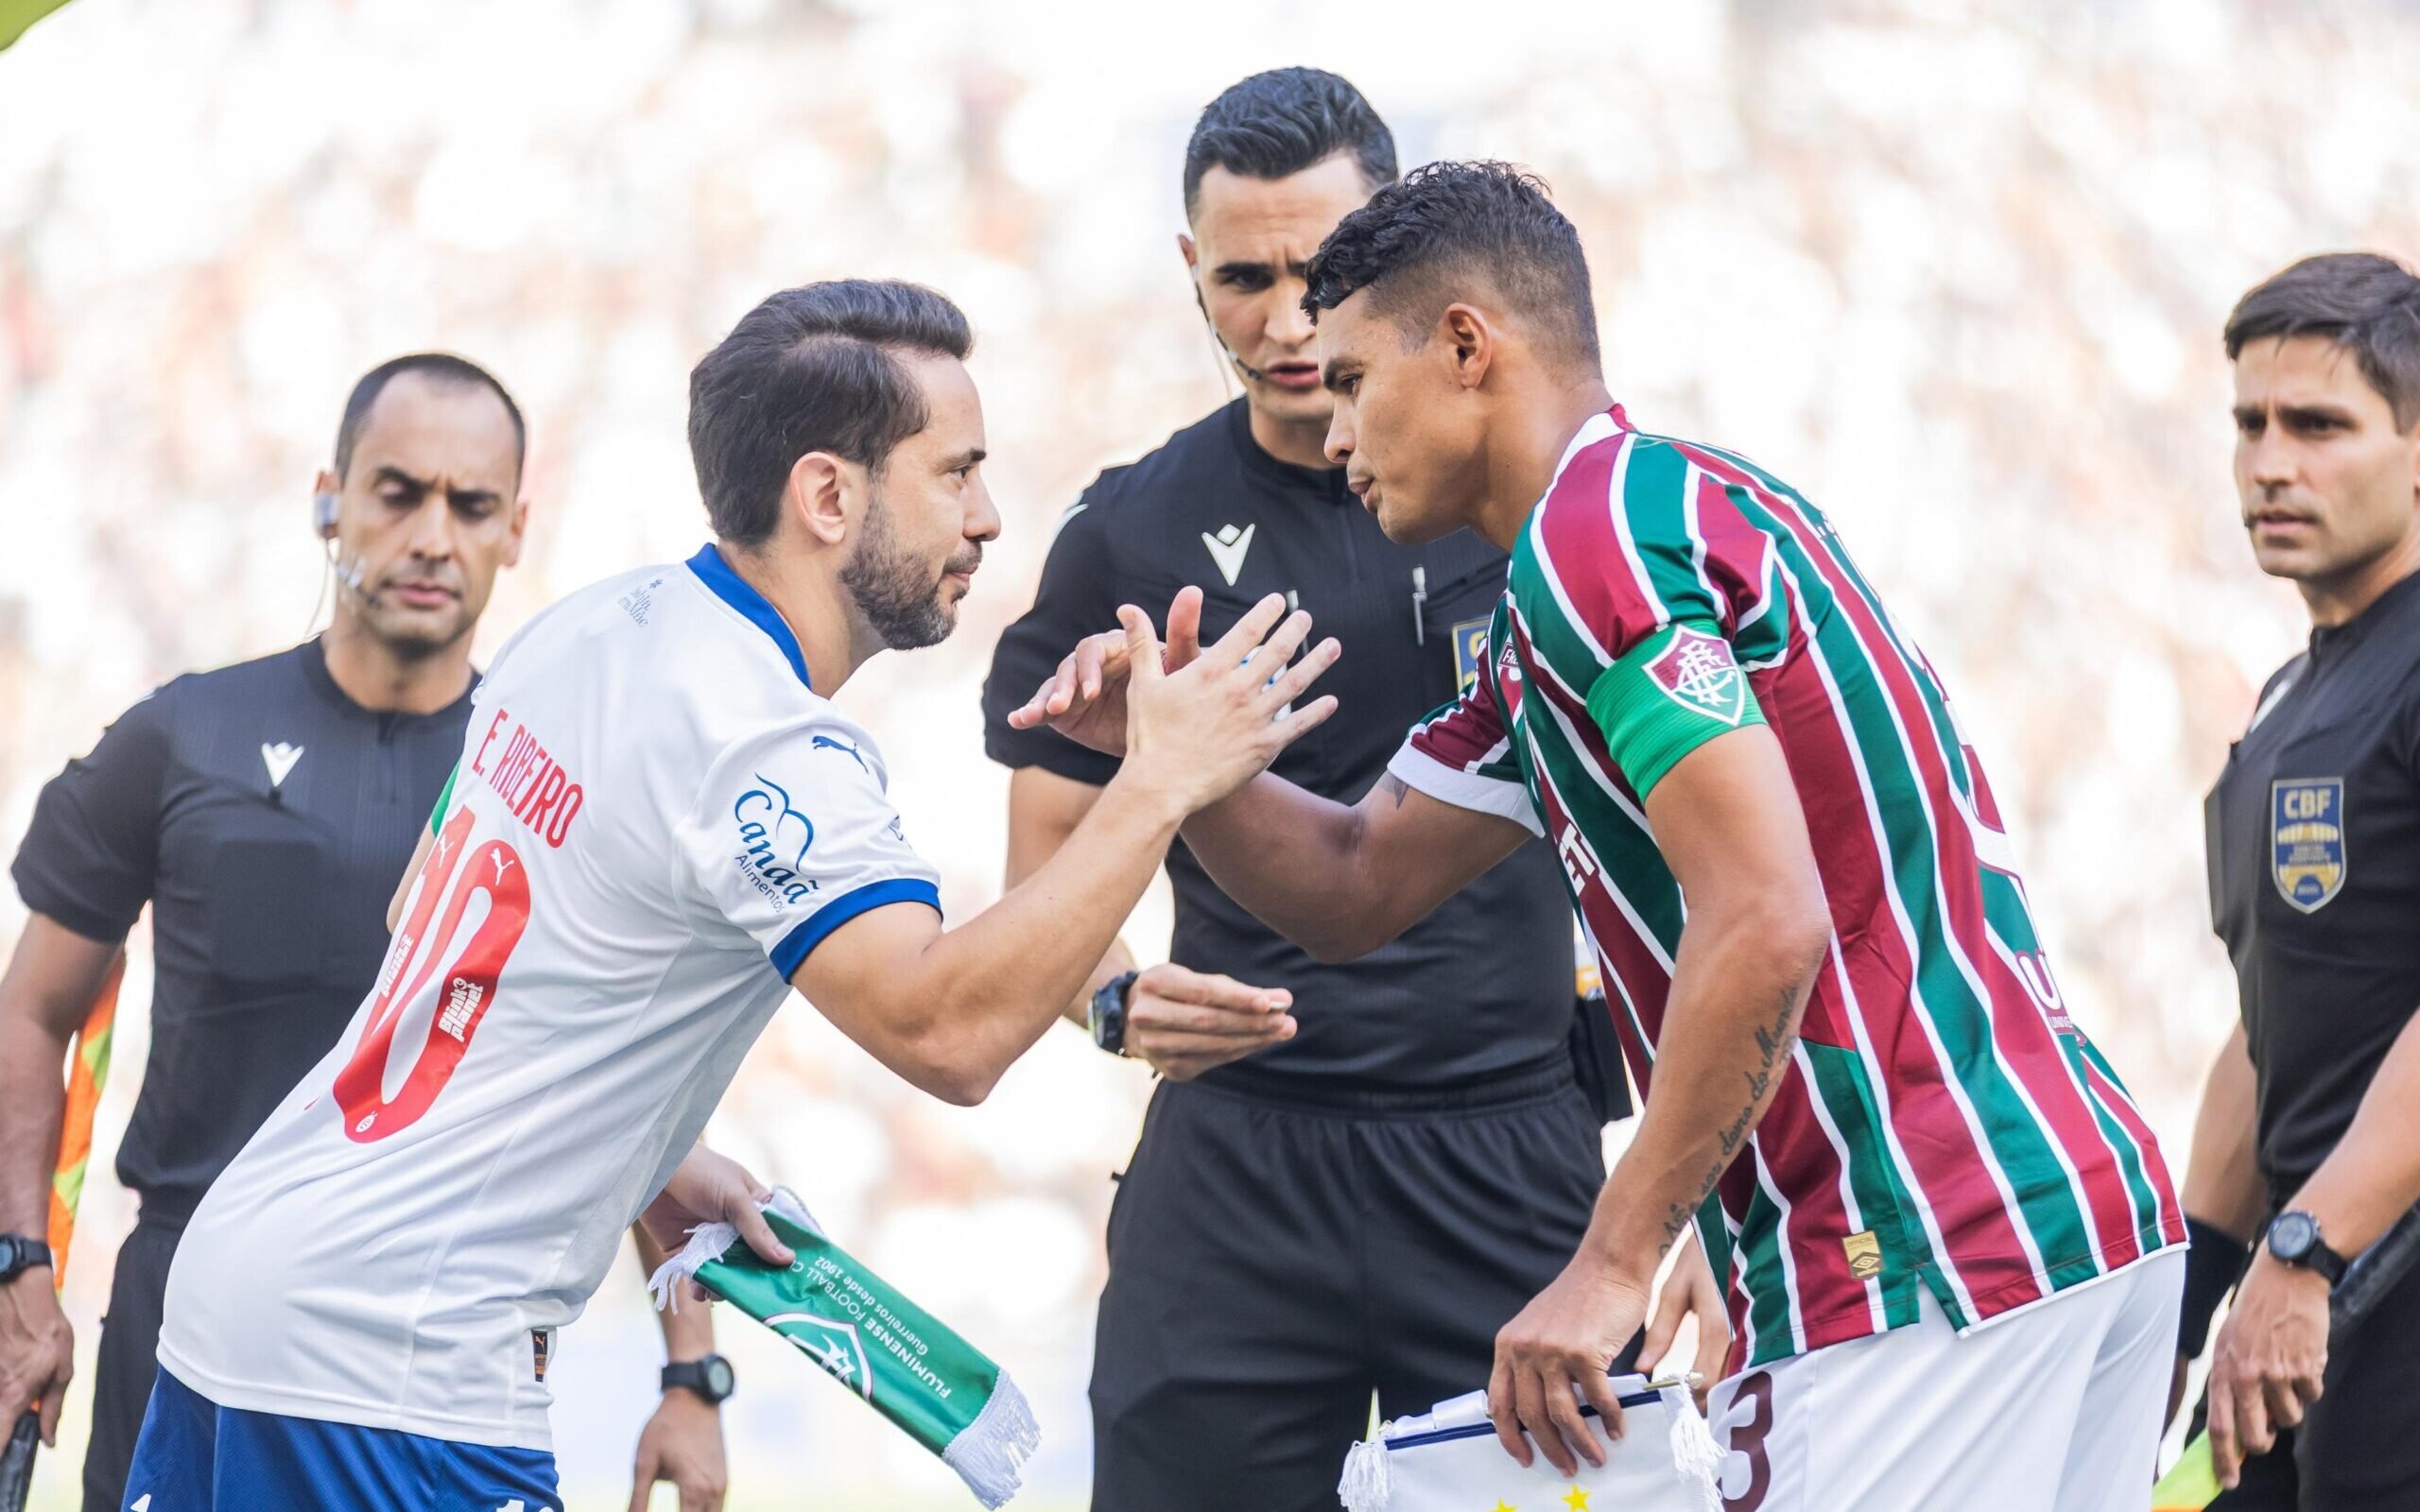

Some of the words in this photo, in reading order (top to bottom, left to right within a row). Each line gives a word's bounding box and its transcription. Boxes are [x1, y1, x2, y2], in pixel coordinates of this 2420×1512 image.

[472, 708, 509, 777] E.
[489, 724, 583, 849] RIBEIRO
[2284, 788, 2331, 819] CBF
[735, 790, 820, 904] Canaã
[735, 854, 786, 913] Alimentos
[333, 804, 531, 1143] 10
[438, 988, 468, 1036] Blink
[450, 982, 484, 1043] planet
[1744, 1070, 1770, 1102] do
[806, 1266, 867, 1321] FOOTBALL
[814, 1256, 844, 1279] 1902
[843, 1276, 876, 1306] desde
[864, 1317, 952, 1399] FLUMINENSE
[874, 1303, 928, 1356] Guerreiros
[1716, 1370, 1773, 1512] 3
